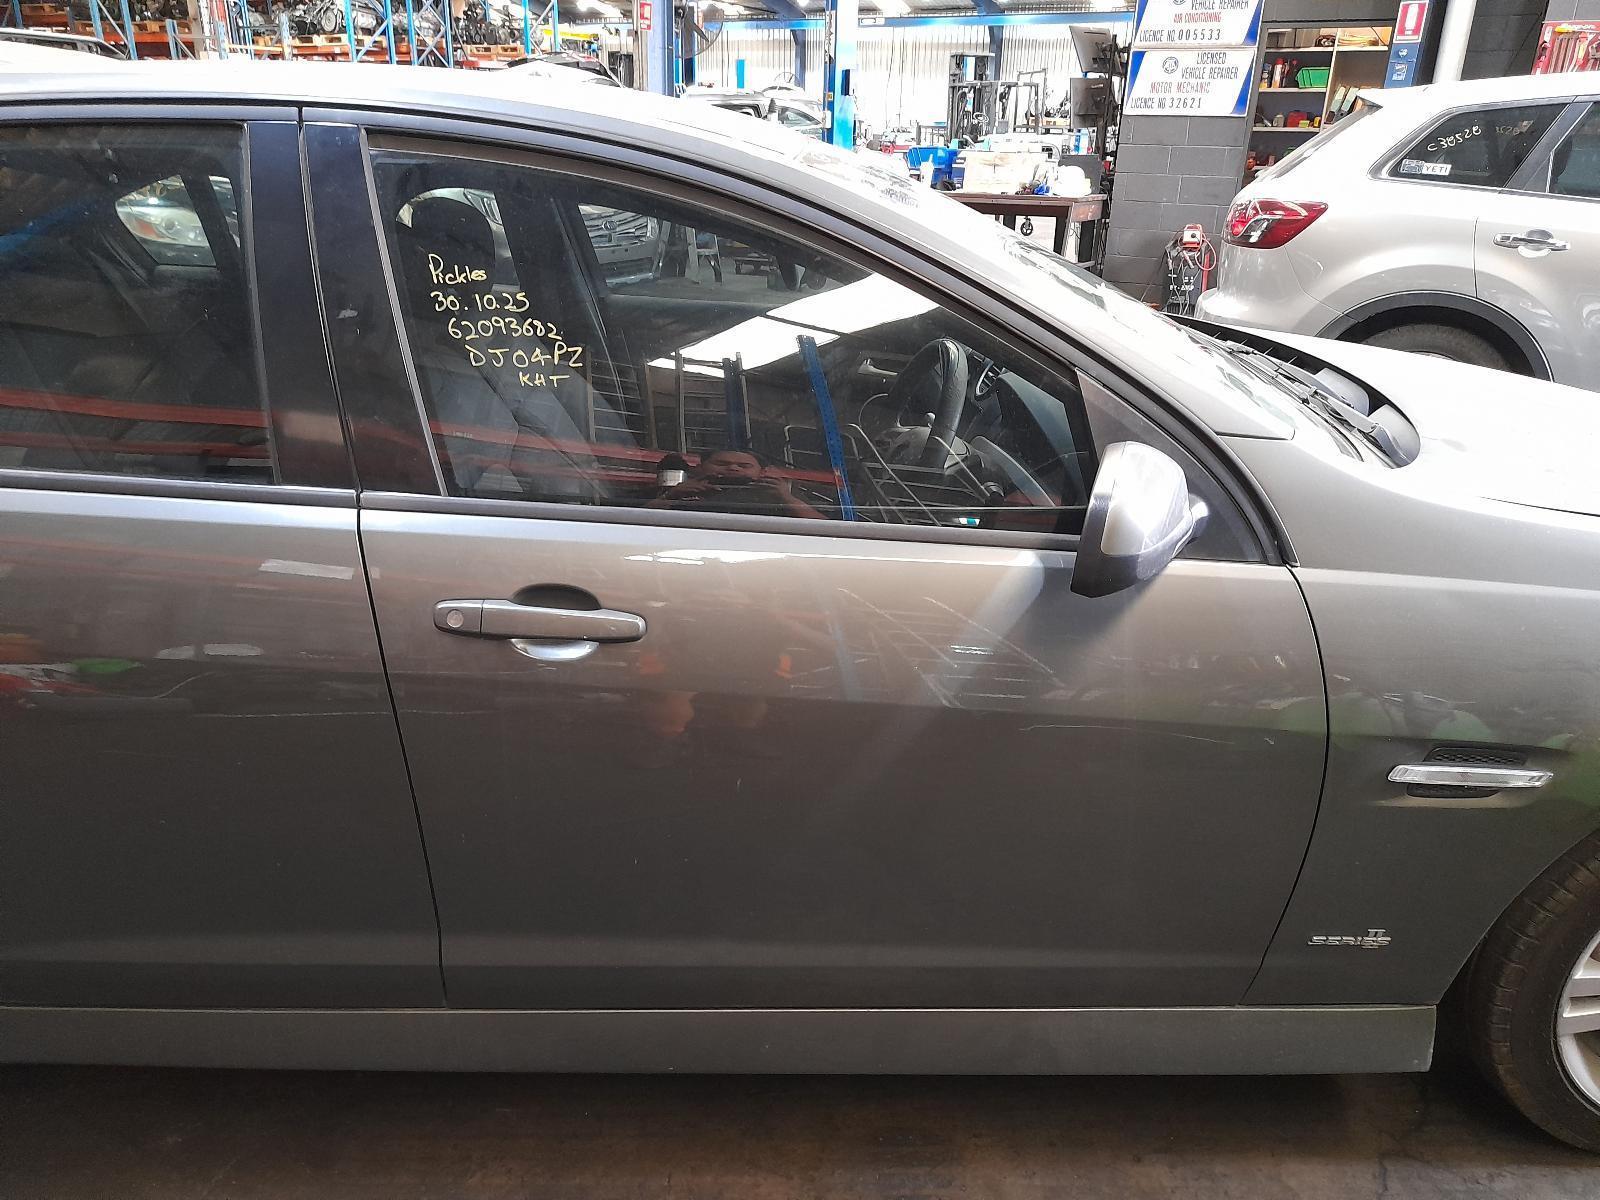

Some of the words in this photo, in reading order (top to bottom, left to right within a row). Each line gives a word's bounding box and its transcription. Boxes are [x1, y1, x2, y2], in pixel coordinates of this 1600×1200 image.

[1184, 12, 1222, 23] CONDITIONING
[1139, 29, 1165, 42] LICENCE
[1178, 28, 1221, 41] 005533
[1196, 52, 1227, 65] LICENSED
[1181, 67, 1206, 79] VEHICLE
[1208, 66, 1239, 79] REPAIRER
[1149, 82, 1173, 94] MOTOR
[1176, 81, 1211, 94] MECHANIC
[1130, 97, 1155, 109] LICENCE
[1168, 97, 1202, 109] 32621
[1425, 165, 1448, 173] YETI
[428, 253, 488, 285] Pickles
[1307, 936, 1392, 946] SERIES
